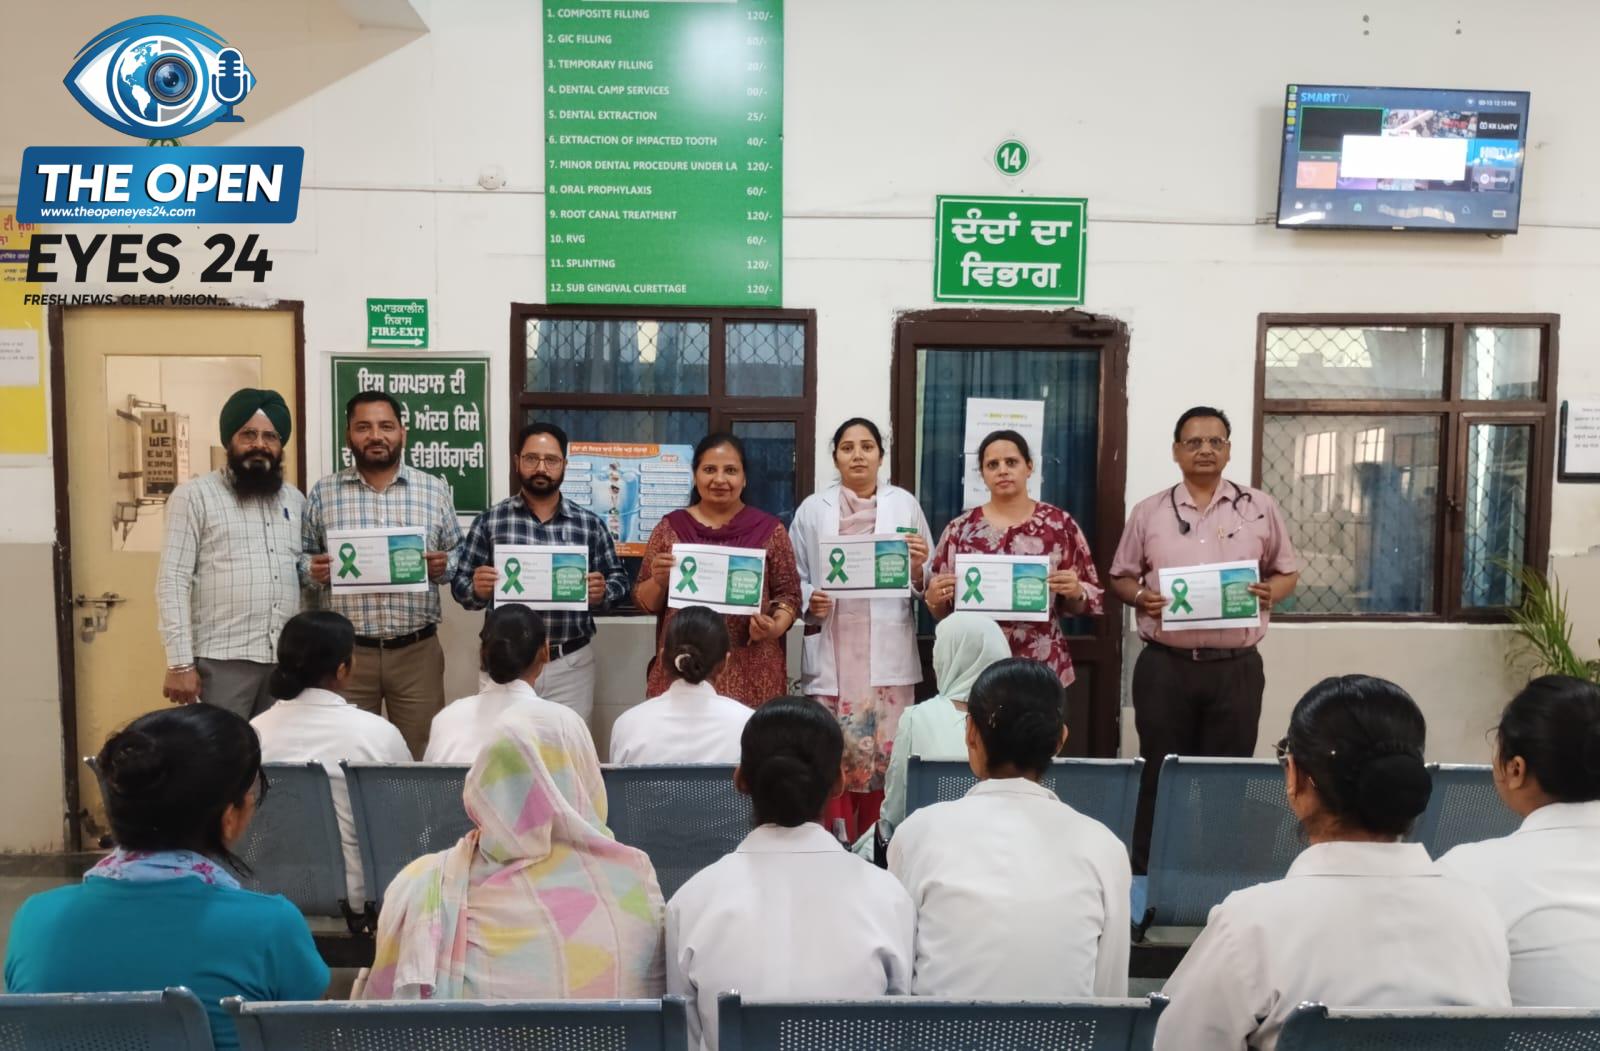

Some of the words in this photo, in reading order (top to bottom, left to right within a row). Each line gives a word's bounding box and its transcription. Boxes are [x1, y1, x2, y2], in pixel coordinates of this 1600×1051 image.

[547, 9, 555, 18] 1.
[558, 9, 612, 19] COMPOSITE
[615, 9, 649, 19] FILLING
[747, 11, 774, 21] 120/-
[547, 34, 555, 43] 2.
[558, 34, 574, 44] GIC
[577, 35, 612, 44] FILLING
[548, 60, 556, 69] 3.
[558, 60, 615, 70] TEMPORARY
[618, 60, 653, 70] FILLING
[548, 86, 557, 94] 4.
[559, 86, 595, 94] DENTAL
[597, 86, 624, 95] CAMP
[626, 86, 670, 96] SERVICES
[549, 110, 557, 119] 5.
[560, 110, 596, 120] DENTAL
[598, 111, 657, 121] EXTRACTION
[747, 112, 767, 122] 25/-
[549, 135, 557, 145] 6.
[560, 135, 619, 145] EXTRACTION
[621, 136, 634, 145] OF
[636, 136, 683, 146] IMPACTED
[684, 136, 717, 146] TOOTH
[747, 137, 767, 147] 40/-
[1000, 147, 1021, 170] 14
[549, 160, 557, 169] 7.
[560, 160, 592, 170] MINOR
[594, 161, 631, 170] DENTAL
[633, 161, 688, 171] PROCEDURE
[691, 161, 723, 171] UNDER
[725, 162, 738, 171] LA
[747, 162, 773, 172] 120/-
[549, 185, 558, 194] 8.
[560, 185, 585, 195] ORAL
[588, 186, 652, 195] PROPHYLAXIS
[747, 187, 767, 197] 60/-
[550, 210, 558, 219] 9.
[560, 210, 586, 219] ROOT
[588, 210, 620, 219] CANAL
[623, 210, 677, 220] TREATMENT
[747, 211, 773, 221] 120/-
[951, 208, 1022, 244] ਦੰਦਾਂ
[1030, 220, 1073, 246] ਦਾ
[550, 234, 564, 243] 10.
[566, 234, 585, 244] RVG
[747, 236, 767, 245] 60/-
[550, 259, 564, 268] 11.
[566, 259, 616, 269] SPLINTING
[747, 261, 773, 270] 120/-
[960, 251, 1062, 289] ਵਿਭਾਗ
[550, 283, 564, 292] 12.
[566, 283, 585, 293] SUB
[587, 284, 632, 294] GINGIVAL
[634, 284, 687, 294] CURETTAGE
[747, 285, 773, 295] 120/-
[370, 302, 425, 314] ਅਪਾਤਕਾਲੀਨ
[384, 314, 412, 326] ਨਿਕਾਸ
[371, 327, 425, 336] FIRE-EXIT
[357, 367, 384, 393] ਇਸ
[389, 374, 446, 394] ਹਸਪਤਾਲ
[449, 368, 466, 394] ਦੀ
[415, 405, 449, 431] ਅੰਦਰ
[453, 402, 480, 431] ਕਿਸੇ
